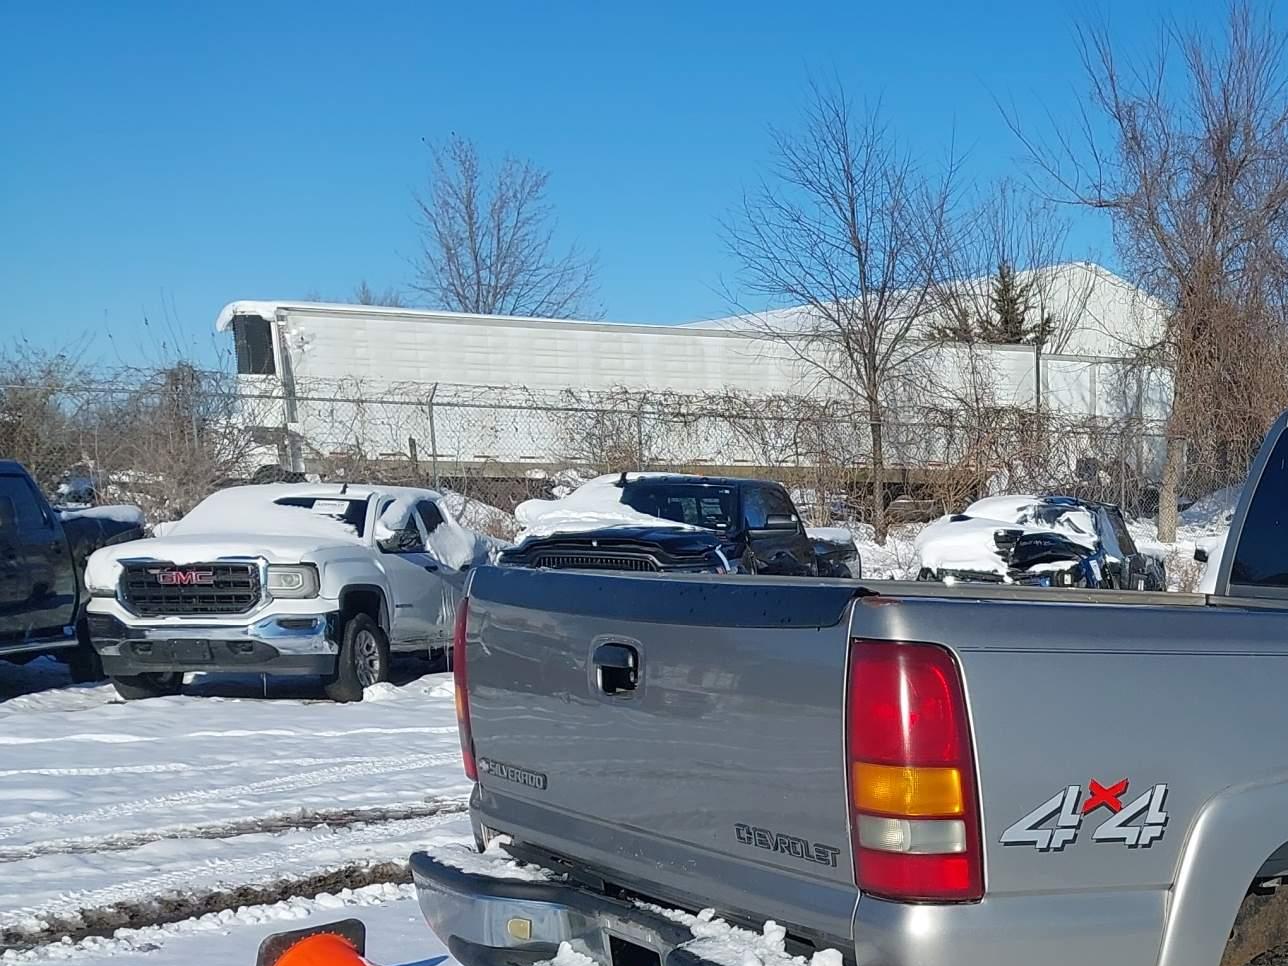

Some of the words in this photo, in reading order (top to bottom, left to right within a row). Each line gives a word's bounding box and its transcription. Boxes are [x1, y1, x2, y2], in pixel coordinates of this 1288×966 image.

[157, 571, 214, 585] GMC
[488, 760, 544, 789] SILVERADO
[734, 822, 841, 868] CHEVROLET
